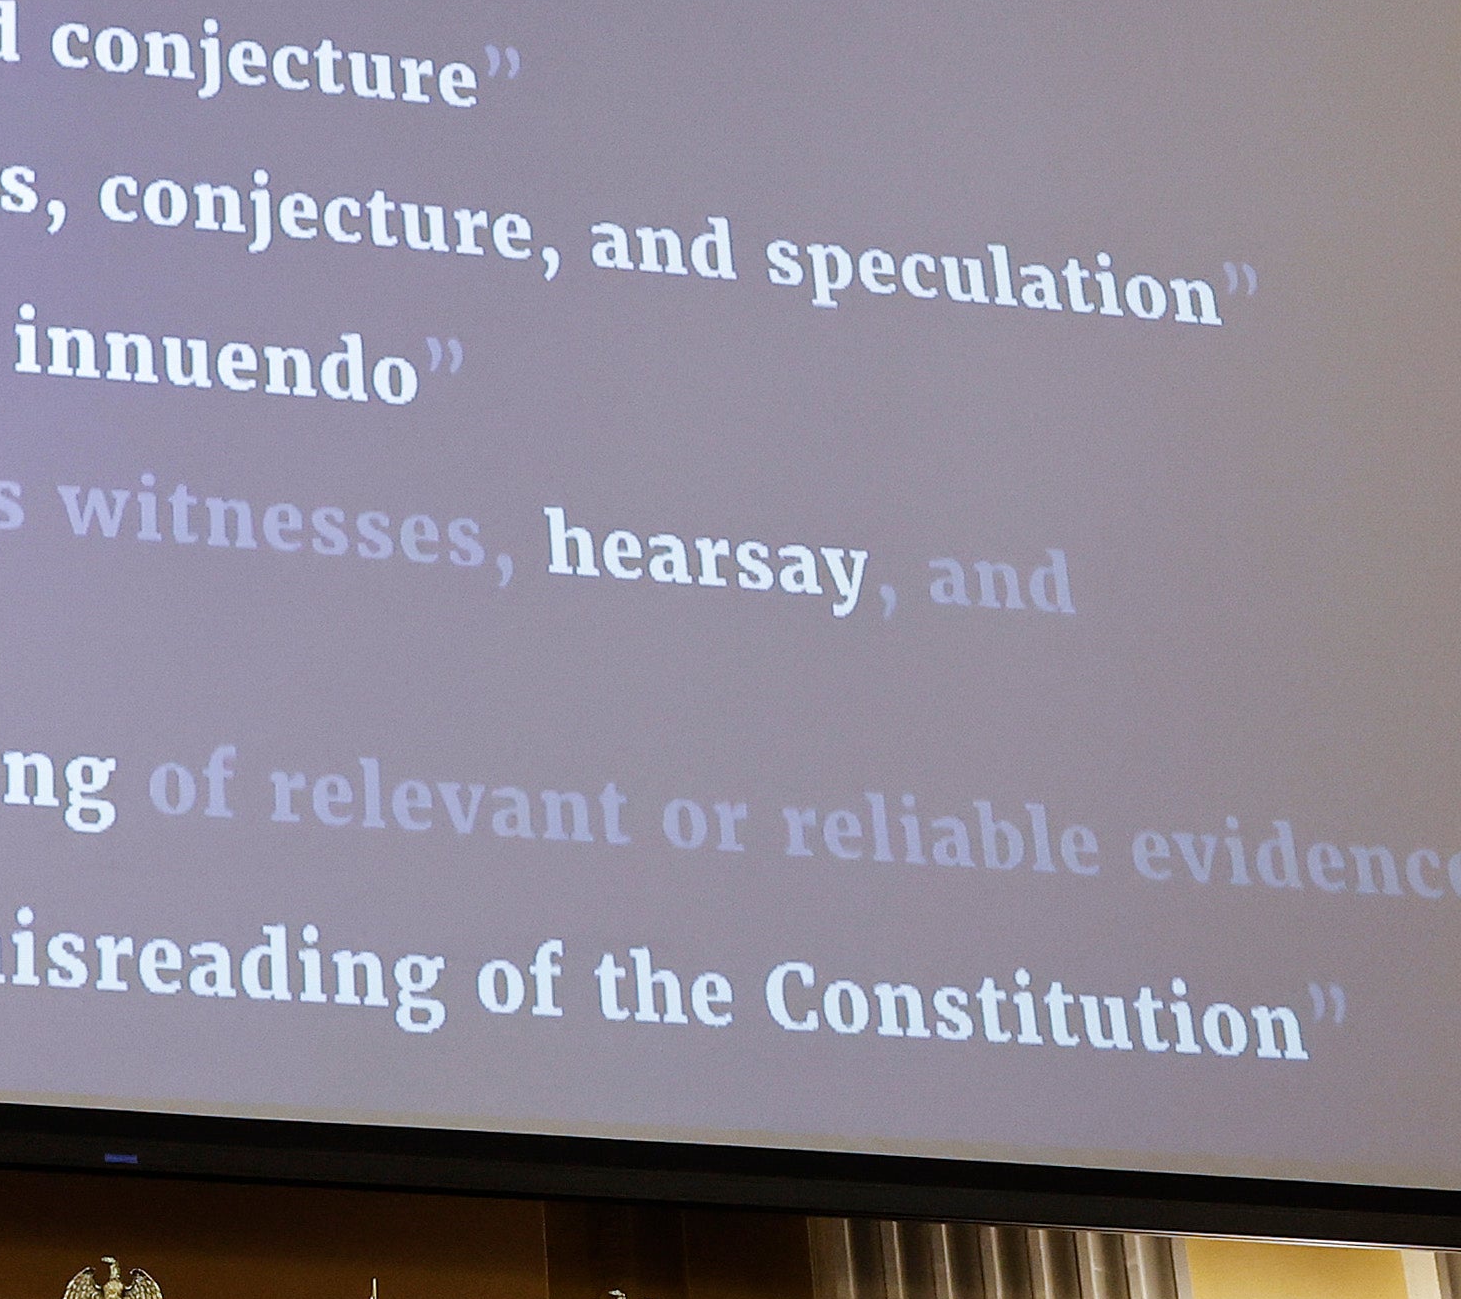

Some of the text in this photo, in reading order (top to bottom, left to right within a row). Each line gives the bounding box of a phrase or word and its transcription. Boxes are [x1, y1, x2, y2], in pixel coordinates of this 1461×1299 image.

[50, 16, 520, 109] conjecture”
[99, 167, 561, 282] conjecture,
[589, 214, 738, 281] and
[764, 237, 1257, 327] speculation”
[13, 301, 463, 406] innuendo”
[57, 471, 513, 587] witnesses,
[542, 504, 897, 618] hearsay,
[928, 548, 1076, 615] and
[148, 744, 236, 818] of
[270, 756, 630, 845] relevant
[662, 798, 748, 851] or
[782, 792, 1099, 875] reliable
[475, 936, 565, 1019] of
[592, 945, 734, 1029] the
[763, 959, 1347, 1064] Constitution”
